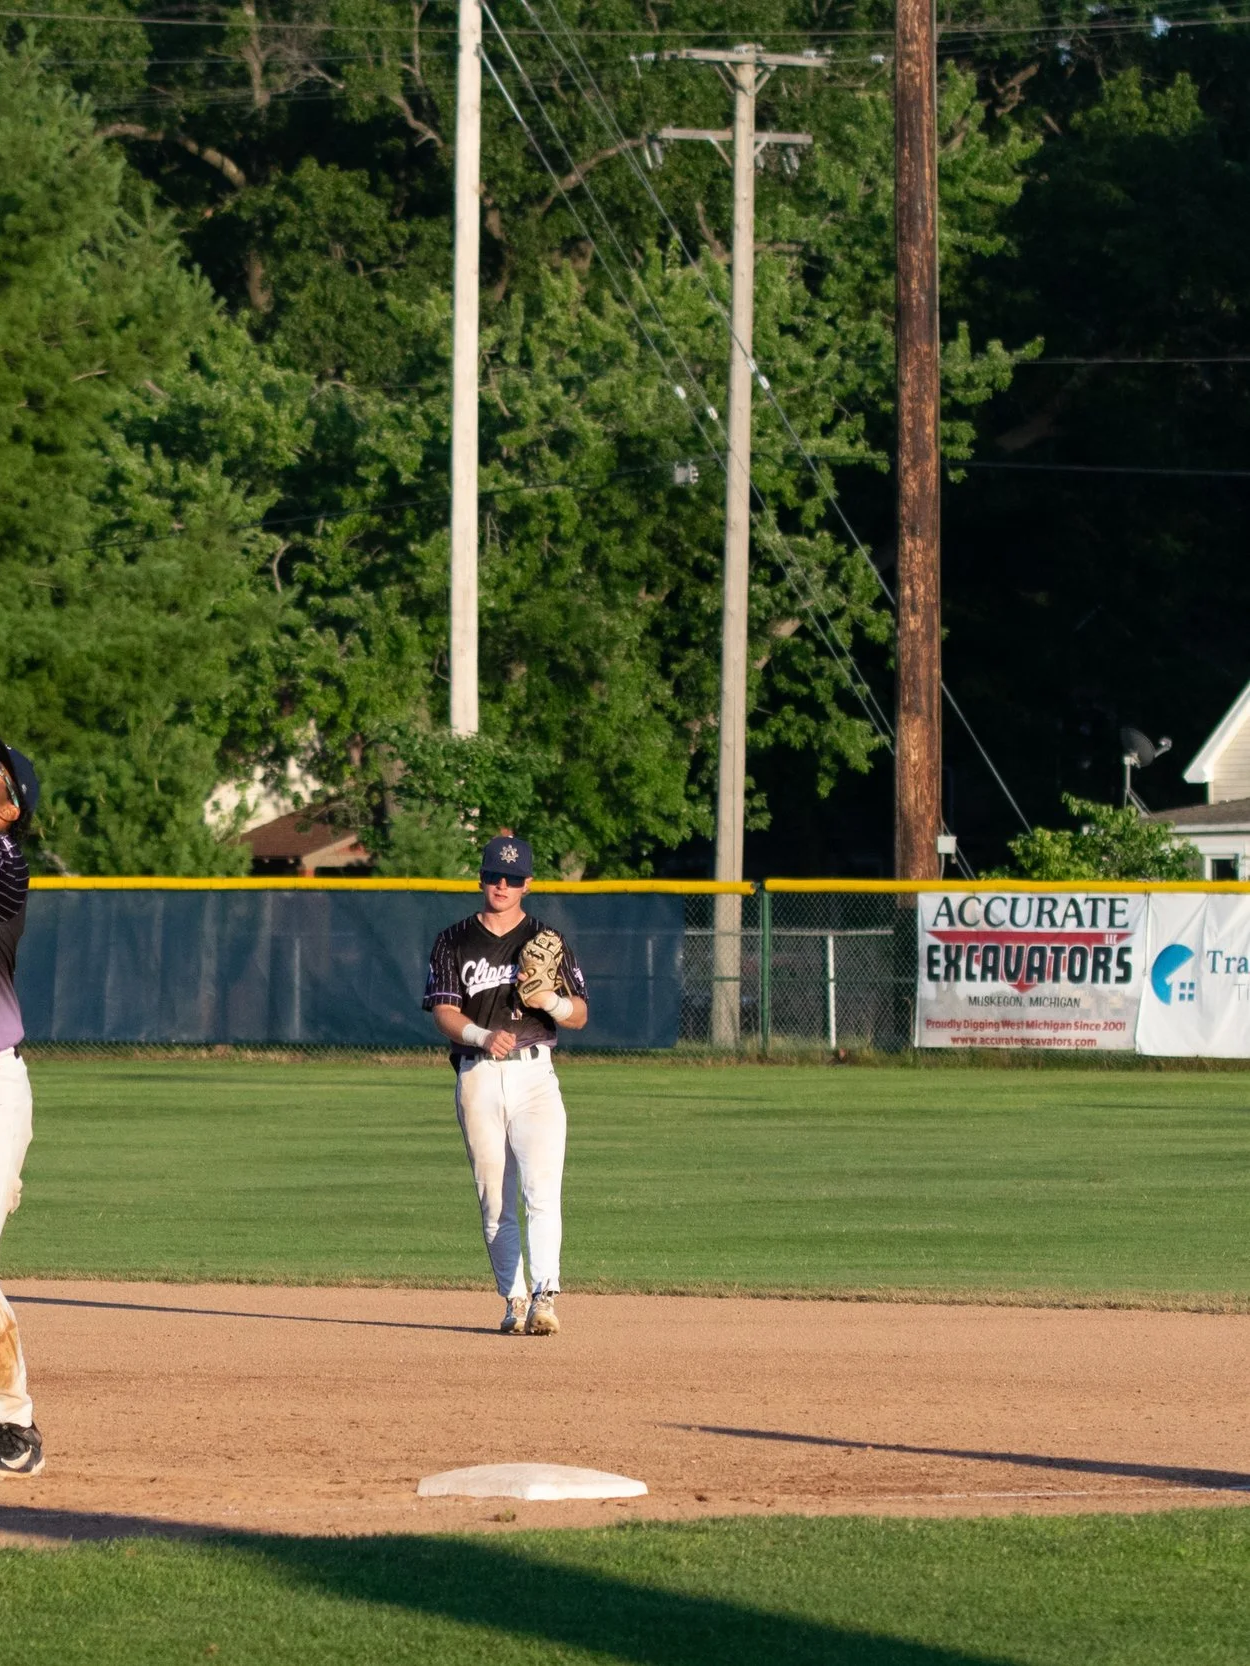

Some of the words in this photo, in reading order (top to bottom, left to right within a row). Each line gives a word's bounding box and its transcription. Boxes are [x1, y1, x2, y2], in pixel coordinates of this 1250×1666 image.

[931, 895, 1130, 929] ACCURATE
[926, 944, 1133, 984] EXCAVATORS
[1029, 997, 1081, 1008] MICHIGAN
[926, 1019, 962, 1031] Proudly
[963, 1019, 1000, 1031] Digging
[1000, 1020, 1025, 1030] West
[1025, 1020, 1072, 1032] Michigan
[1073, 1021, 1102, 1031] Since
[1102, 1021, 1126, 1032] 2001
[951, 1036, 1097, 1047] www.accurateexcavators.com
